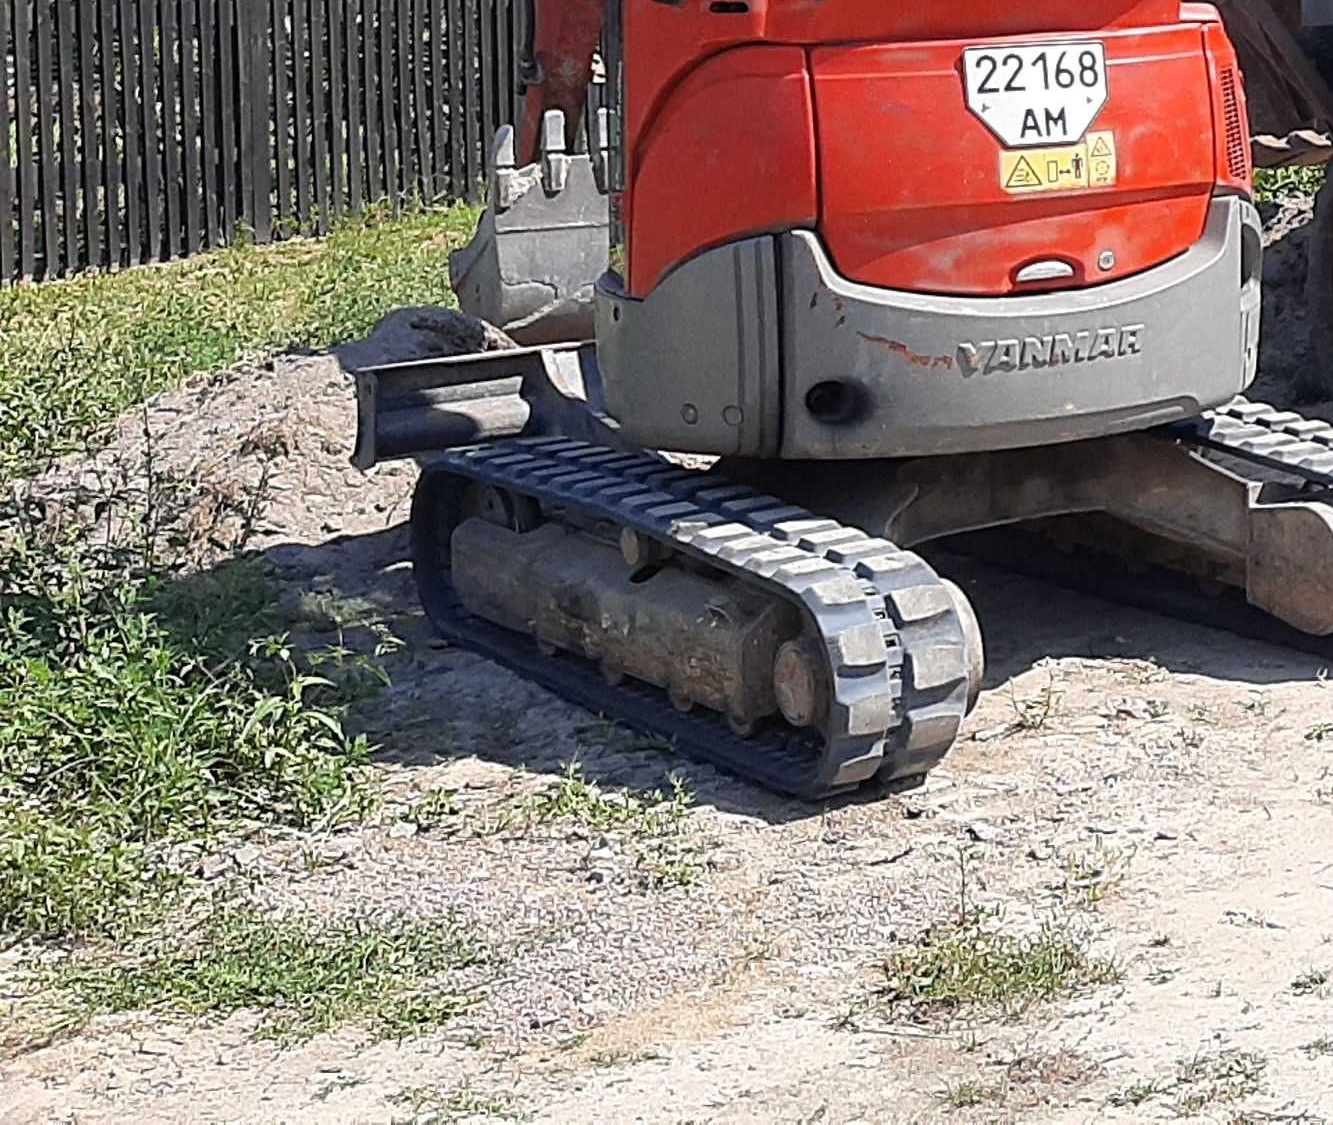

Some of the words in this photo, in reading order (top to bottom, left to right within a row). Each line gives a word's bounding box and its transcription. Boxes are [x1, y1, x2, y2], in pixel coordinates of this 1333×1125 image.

[975, 51, 1099, 94] 22168
[1020, 106, 1068, 138] AM
[956, 323, 1145, 378] YANMAR
